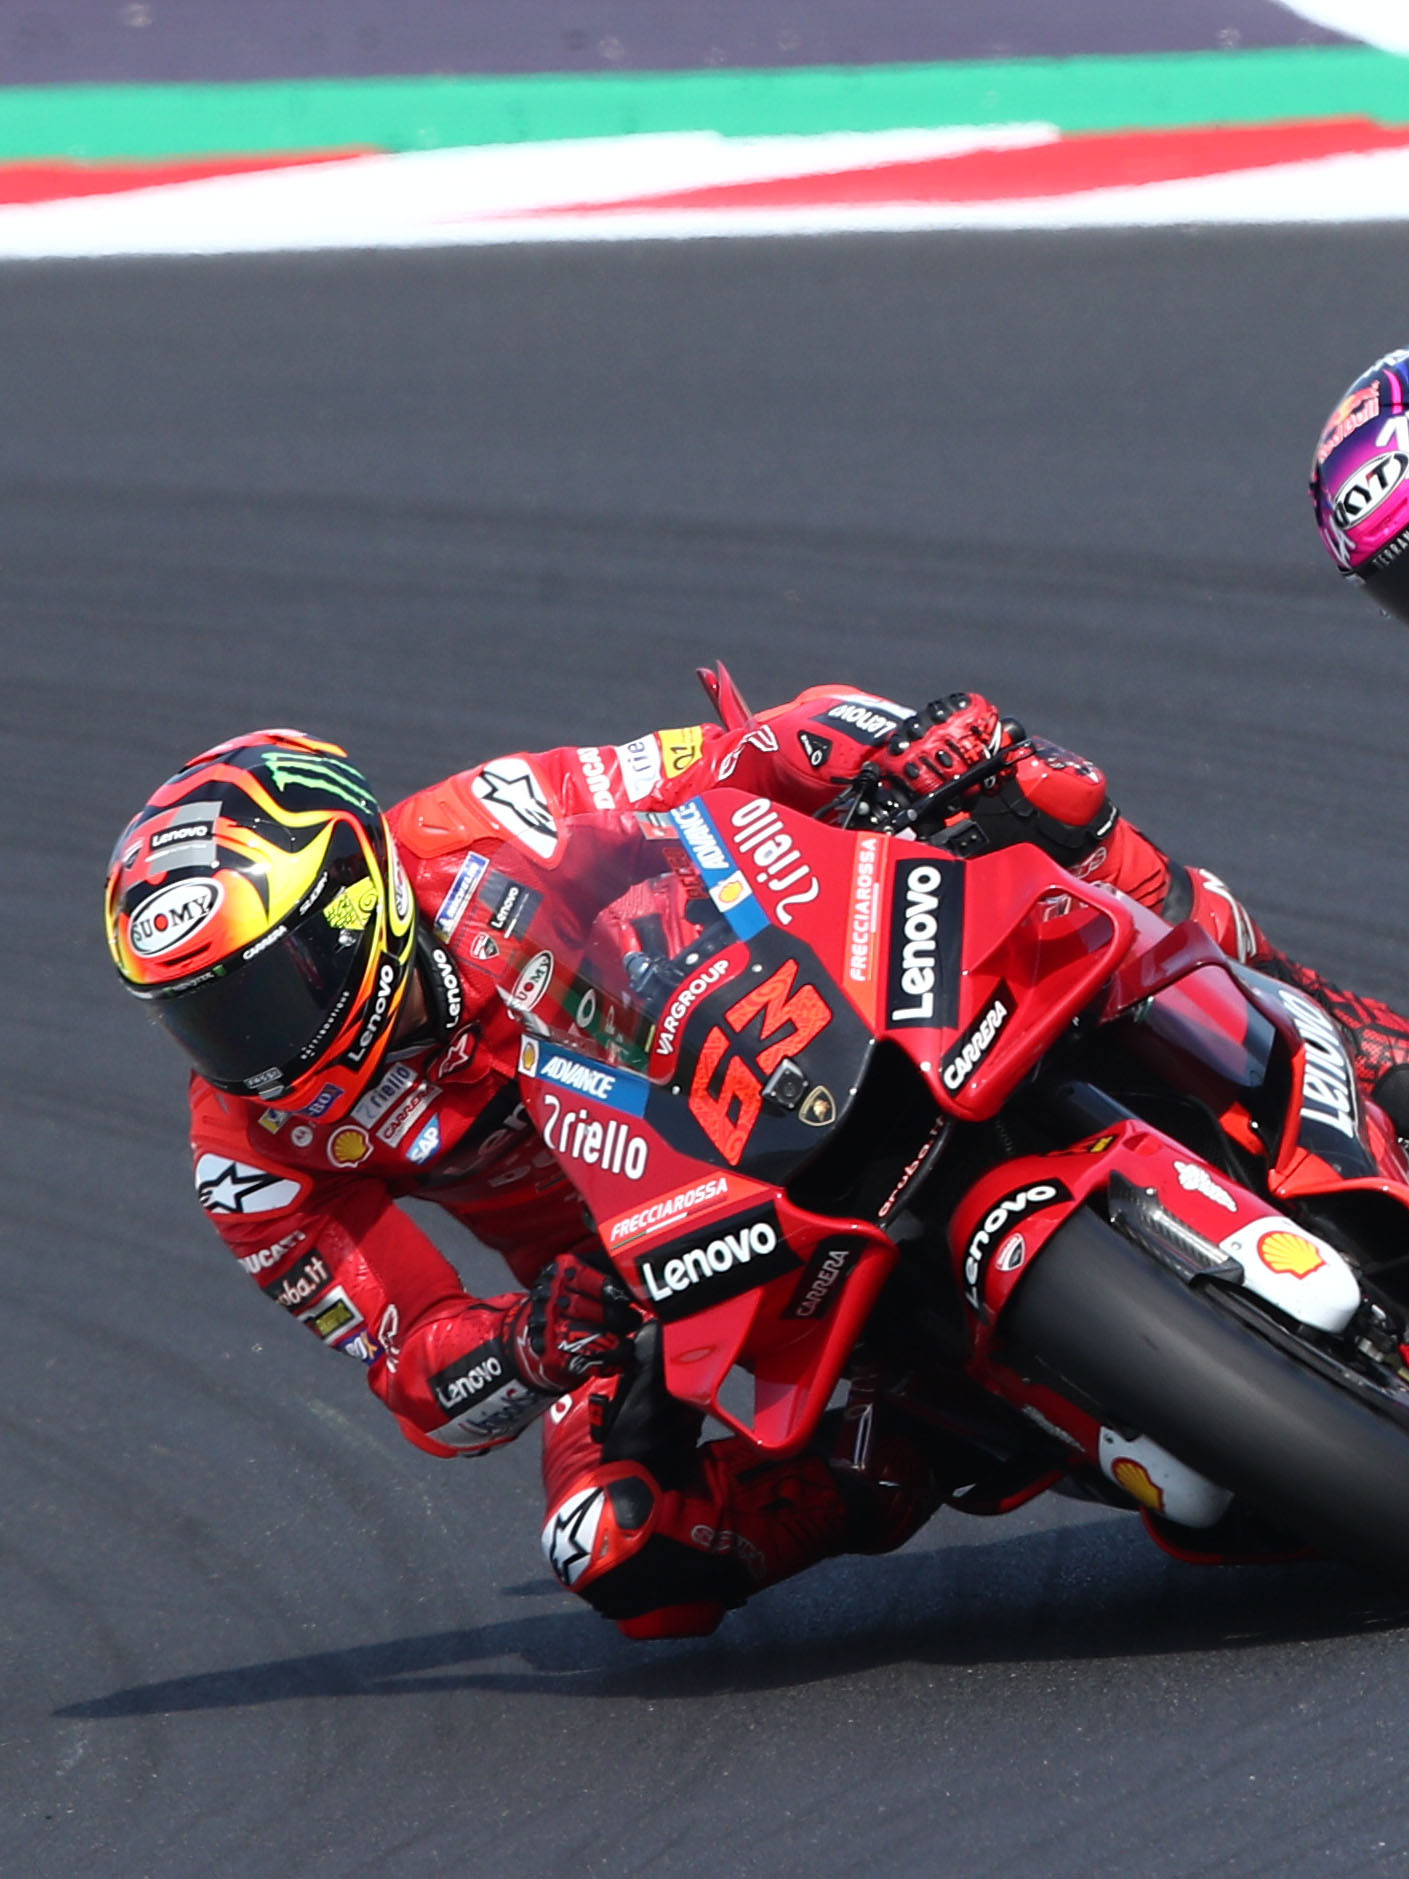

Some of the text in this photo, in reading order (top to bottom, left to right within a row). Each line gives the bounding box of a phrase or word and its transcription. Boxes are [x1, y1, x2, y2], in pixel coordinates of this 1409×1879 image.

[1334, 464, 1398, 522] KYT
[152, 825, 208, 848] Lenovo
[671, 799, 730, 870] ADVANCE
[131, 893, 211, 943] SUOMY
[491, 887, 519, 928] Lenovo
[850, 838, 878, 982] FRECCIAROSSA
[891, 864, 944, 1020] Lenovo
[347, 964, 395, 1062] Lenovo
[433, 948, 462, 1029] Lenovo
[540, 1055, 617, 1099] ADVANCE
[688, 957, 834, 1167] 63
[943, 1000, 1008, 1090] CARRERA
[410, 1126, 440, 1165] SAP
[610, 1177, 729, 1242] FRECCIAROSSA
[642, 1222, 777, 1302] Lenovo
[965, 1185, 1057, 1309] Lenovo
[796, 1248, 849, 1318] CARRERA
[436, 1356, 503, 1409] Lenovo
